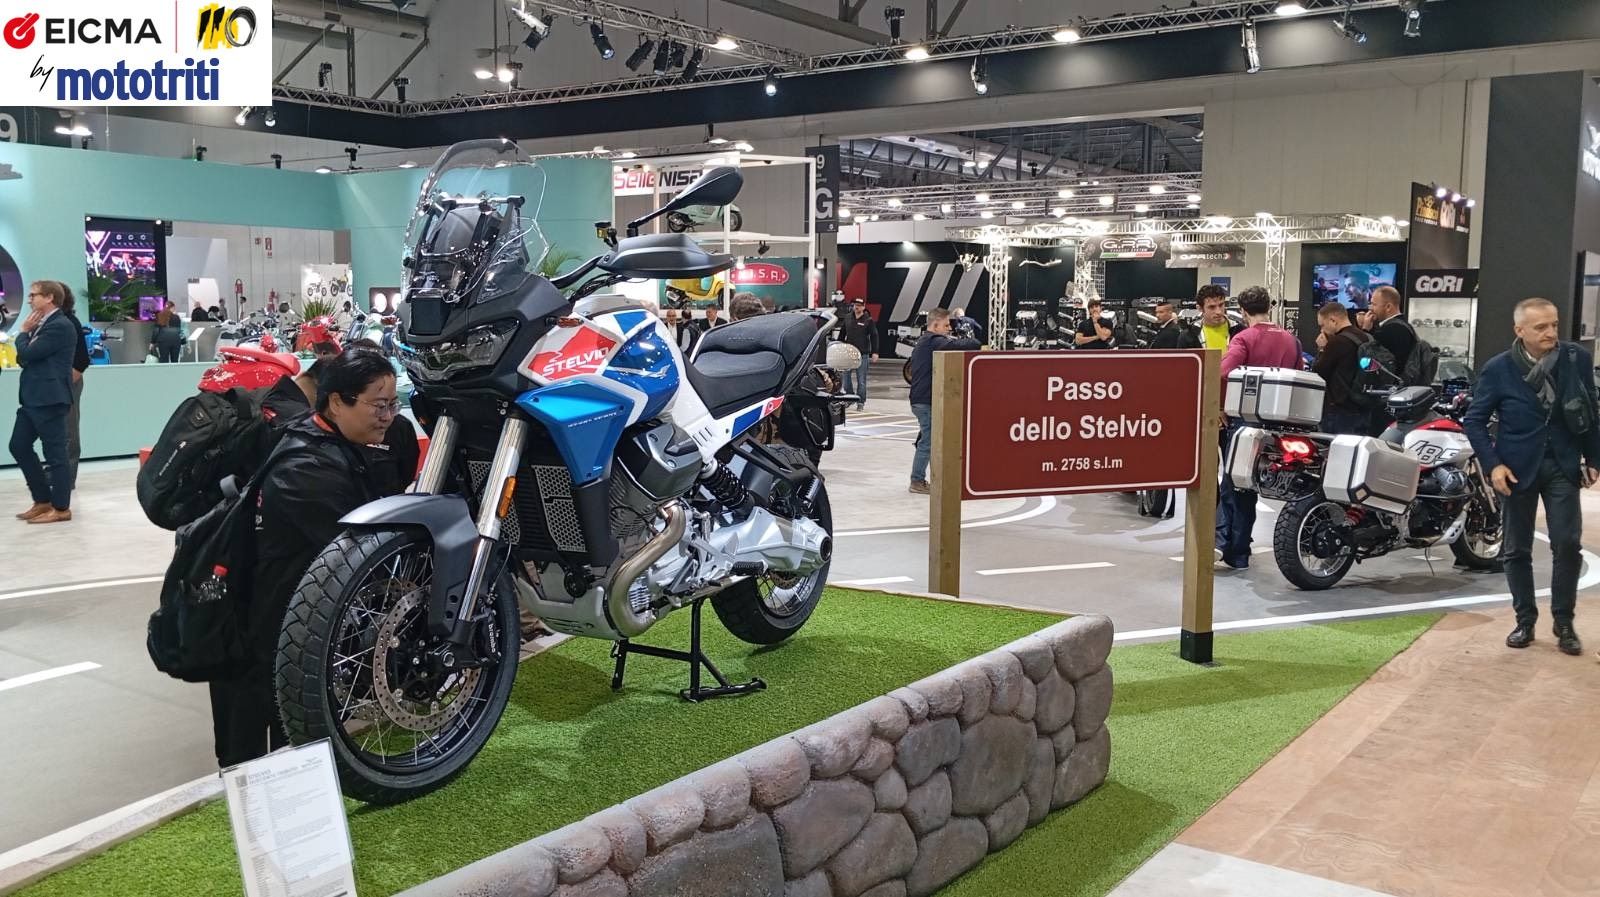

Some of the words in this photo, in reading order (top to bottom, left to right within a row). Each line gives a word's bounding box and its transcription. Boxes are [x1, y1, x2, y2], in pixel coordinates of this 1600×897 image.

[815, 187, 833, 219] G
[541, 347, 609, 377] STELVIO
[1047, 376, 1123, 401] Passo
[1009, 416, 1072, 442] dello
[1079, 413, 1162, 439] Stelvio
[1042, 461, 1057, 471] m.
[1061, 457, 1090, 471] 2758
[1093, 456, 1123, 469] s.l.m
